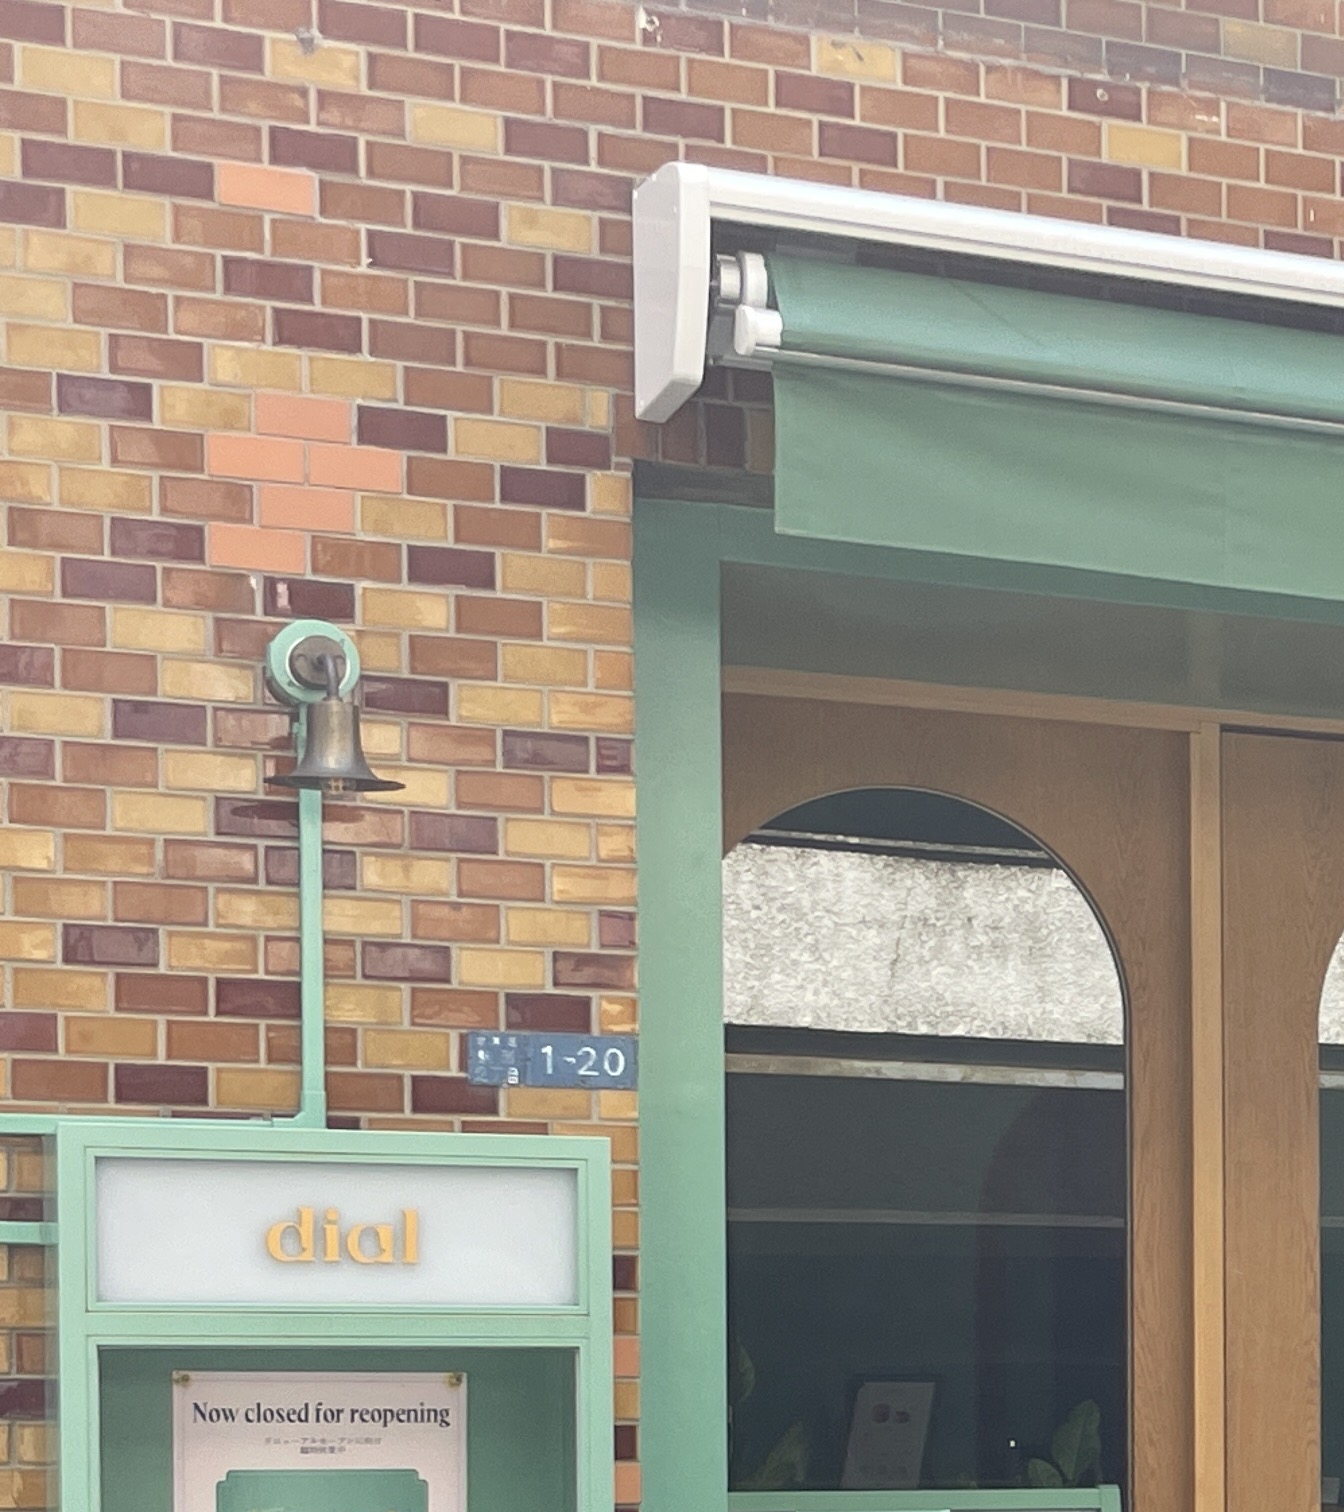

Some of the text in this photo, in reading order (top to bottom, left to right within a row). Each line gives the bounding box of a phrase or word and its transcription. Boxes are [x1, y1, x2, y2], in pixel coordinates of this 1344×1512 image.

[540, 1045, 626, 1077] 1-20
[266, 1206, 420, 1264] dial
[192, 1402, 451, 1427] Now closed for reopening
